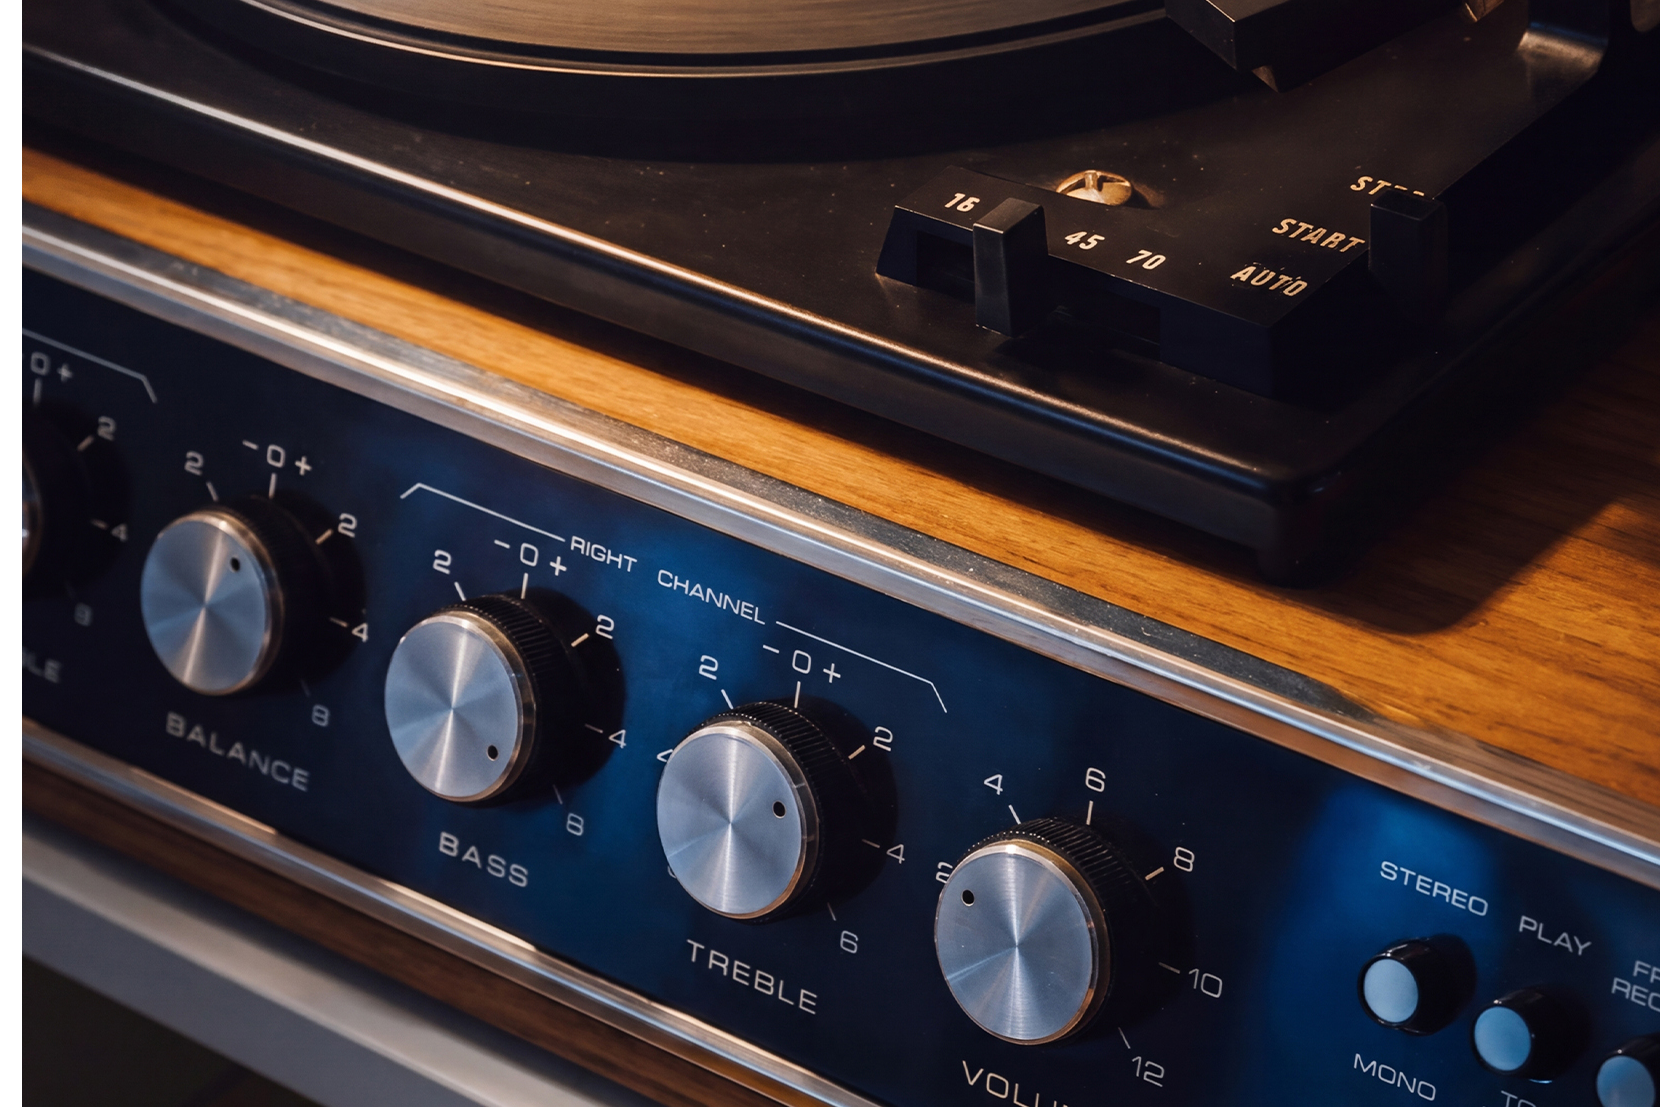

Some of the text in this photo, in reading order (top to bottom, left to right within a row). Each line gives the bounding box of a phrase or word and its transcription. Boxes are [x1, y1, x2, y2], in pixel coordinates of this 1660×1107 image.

[1350, 176, 1425, 197] ST
[944, 192, 980, 213] 16
[1271, 217, 1366, 253] START
[1064, 231, 1166, 270] 45 70
[1229, 265, 1308, 297] AUTO
[97, 415, 117, 441] 2
[184, 451, 204, 475] 2
[337, 513, 358, 538] 2
[432, 549, 452, 575] 2
[570, 535, 766, 626] RIGHT CHANNEL
[351, 622, 369, 643] 4
[595, 614, 615, 639] 2
[698, 654, 718, 680] 2
[311, 704, 330, 727] 8
[165, 711, 311, 792] BALANCE
[608, 729, 627, 749] 4
[873, 725, 893, 752] 2
[983, 773, 1004, 796] 4
[1085, 767, 1106, 793] 6
[567, 812, 584, 836] 8
[438, 831, 529, 888] BASS
[886, 843, 906, 865] 4
[1173, 846, 1195, 872] 8
[1379, 860, 1489, 917] STEREO
[840, 929, 859, 954] 6
[1518, 915, 1592, 956] PLAY
[686, 938, 819, 1015] TREBLE
[1188, 967, 1224, 999] 10
[1131, 1055, 1165, 1088] 12
[1353, 1052, 1437, 1102] MONO
